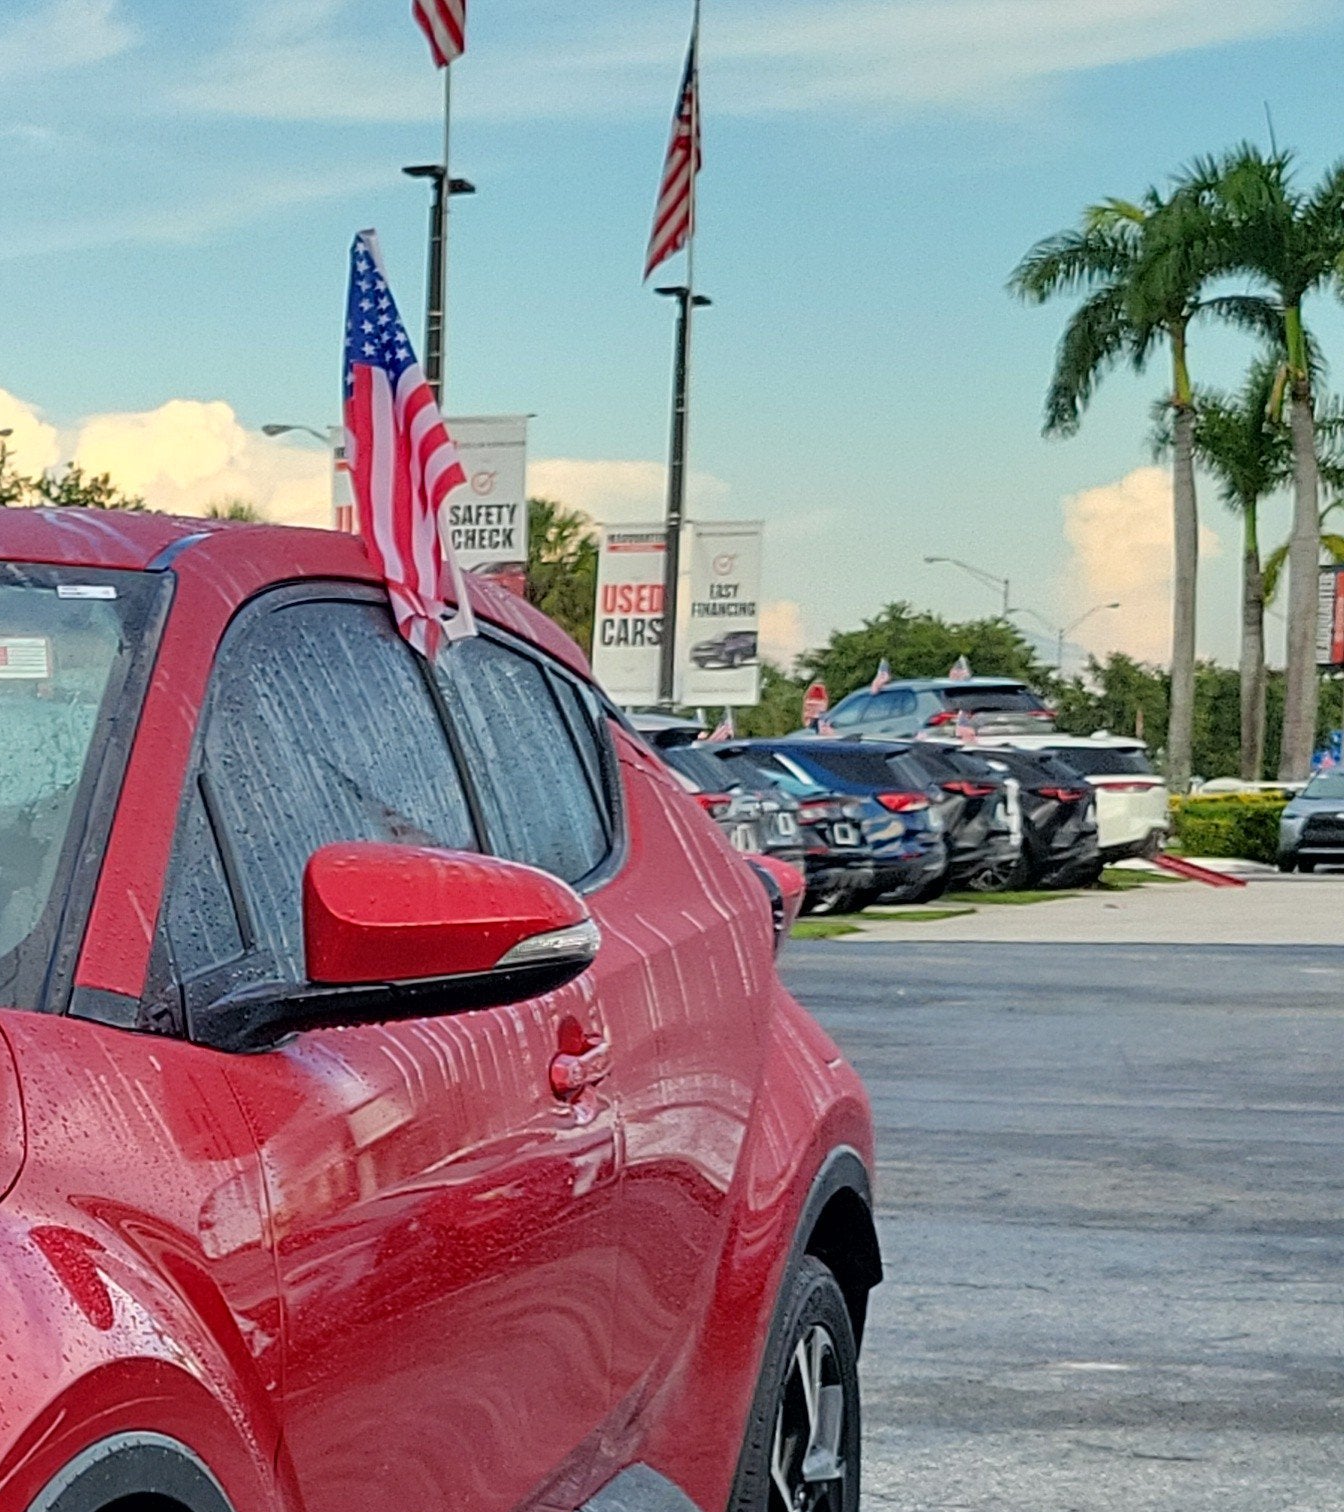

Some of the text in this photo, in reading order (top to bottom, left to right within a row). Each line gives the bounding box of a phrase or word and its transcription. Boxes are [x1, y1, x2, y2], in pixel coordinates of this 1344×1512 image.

[449, 503, 517, 526] SAFETY
[451, 528, 515, 550] CHECK
[603, 584, 666, 615] USED
[601, 618, 665, 647] CARS
